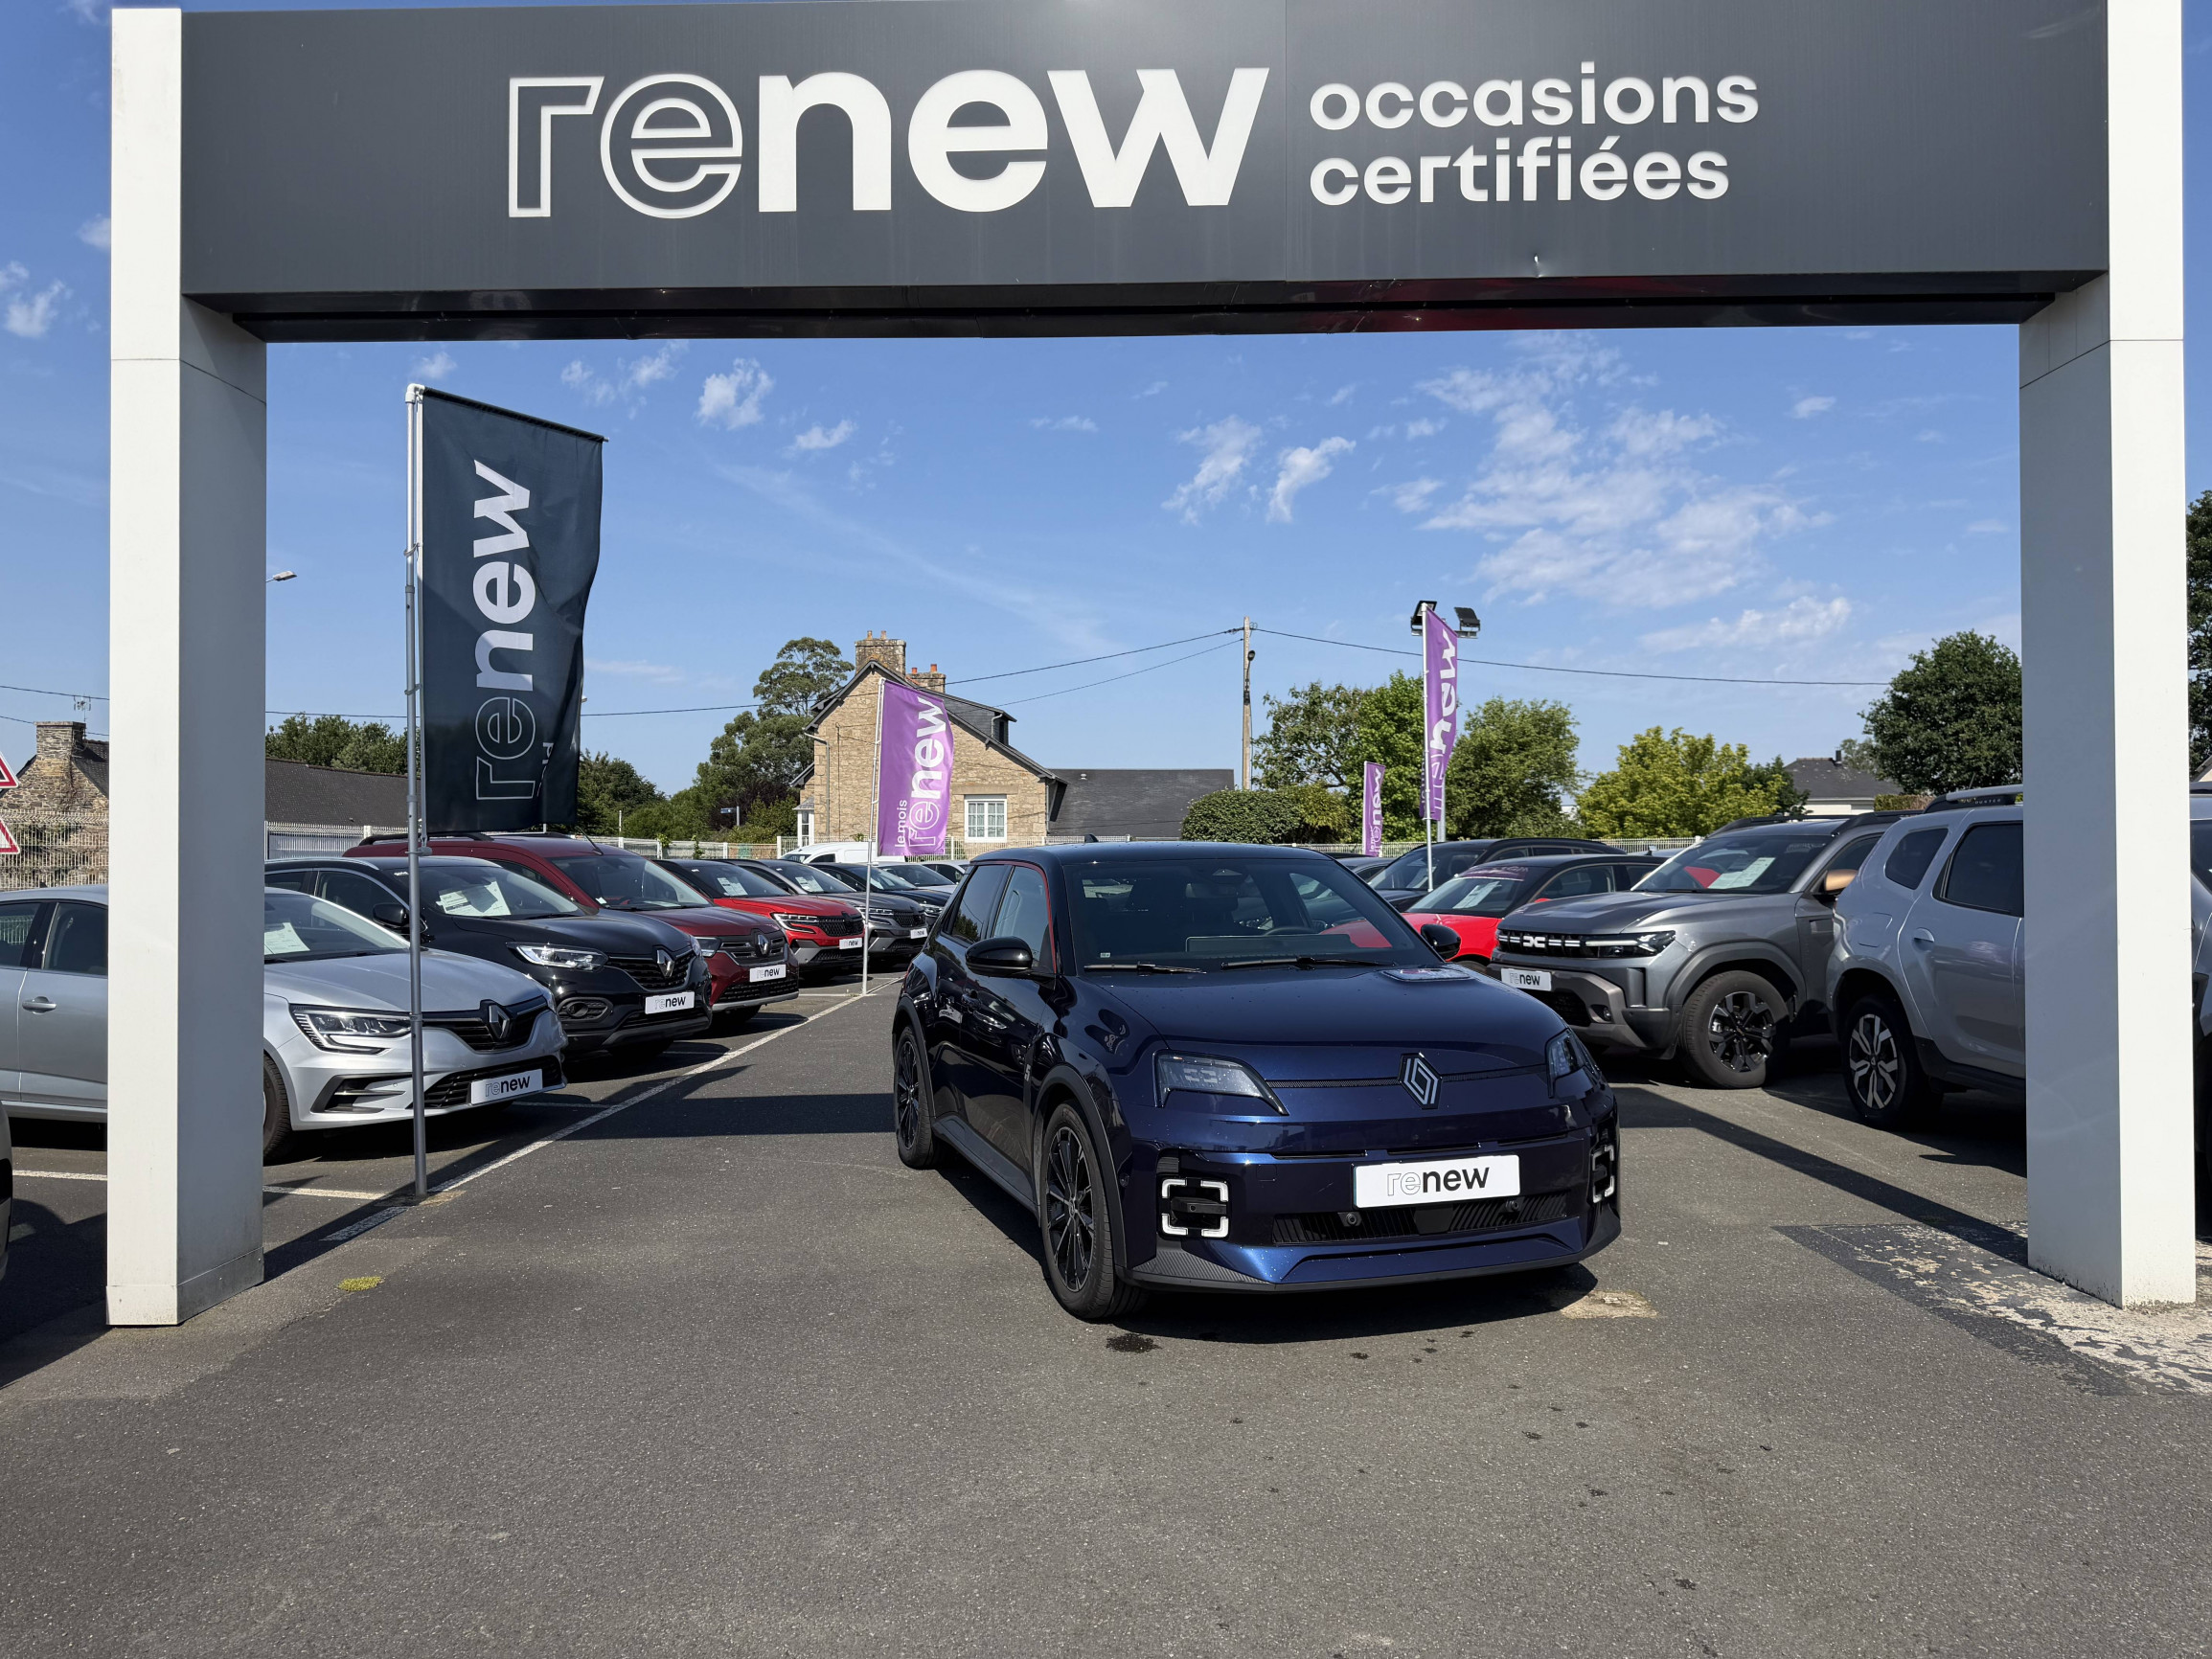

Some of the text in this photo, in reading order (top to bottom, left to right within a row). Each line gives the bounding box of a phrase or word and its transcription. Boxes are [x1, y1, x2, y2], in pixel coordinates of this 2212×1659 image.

[1310, 61, 1759, 130] occasions
[509, 67, 1270, 218] renew
[1310, 135, 1729, 206] certifiées
[472, 459, 536, 801] renew
[909, 696, 946, 847] renew
[897, 799, 908, 833] mois
[485, 1076, 531, 1098] renew
[1386, 1167, 1491, 1196] renew
